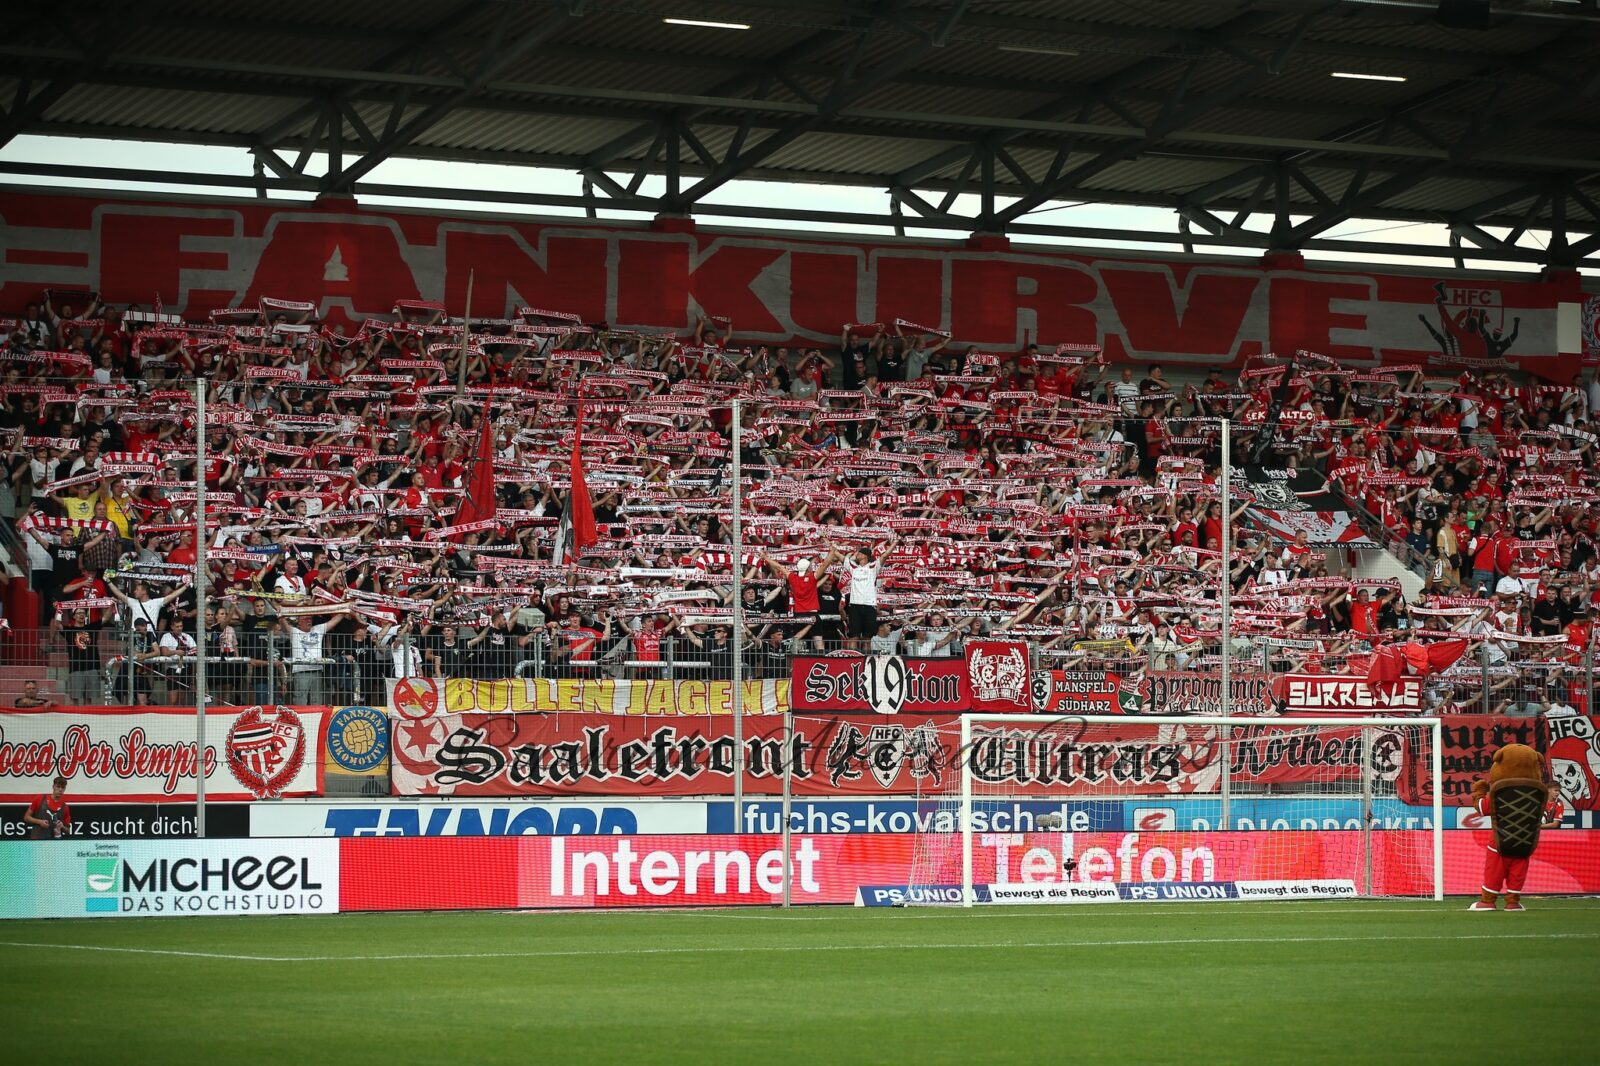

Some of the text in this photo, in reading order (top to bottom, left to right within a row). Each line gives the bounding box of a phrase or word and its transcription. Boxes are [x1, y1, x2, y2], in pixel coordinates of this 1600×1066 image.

[1453, 289, 1492, 304] HFC
[1246, 411, 1266, 421] SEK
[1279, 410, 1314, 421] ALTLO
[1171, 437, 1202, 445] HALLESCHER
[919, 571, 967, 579] HFC-FANKURVE
[1065, 671, 1106, 681] SEKTION
[1055, 681, 1116, 693] MANSFELD
[1143, 675, 1266, 711] Pyromnie
[444, 679, 614, 715] BULLEN
[626, 679, 764, 716] JAGEN
[1058, 697, 1111, 711] SÜDHARZ
[1189, 699, 1266, 714] Leideschaft
[336, 709, 386, 735] FANSZENE
[1549, 718, 1588, 741] HFC
[875, 728, 900, 740] HFC
[331, 731, 386, 765] LOKOMOTIVE
[0, 724, 216, 794] oesa Per Sempre
[433, 725, 812, 787] Saalefront
[968, 726, 1181, 787] Ultras
[90, 817, 145, 835] sucht
[151, 816, 199, 835] dich!
[981, 832, 1215, 884] Telefon
[549, 836, 821, 897] Internet
[873, 888, 904, 903] PS
[994, 886, 1116, 899] bewegt die Region
[1131, 885, 1227, 899] PS UNION
[1241, 885, 1354, 896] bewegt die Region
[123, 894, 324, 912] DAS KOCHSTUDIO
